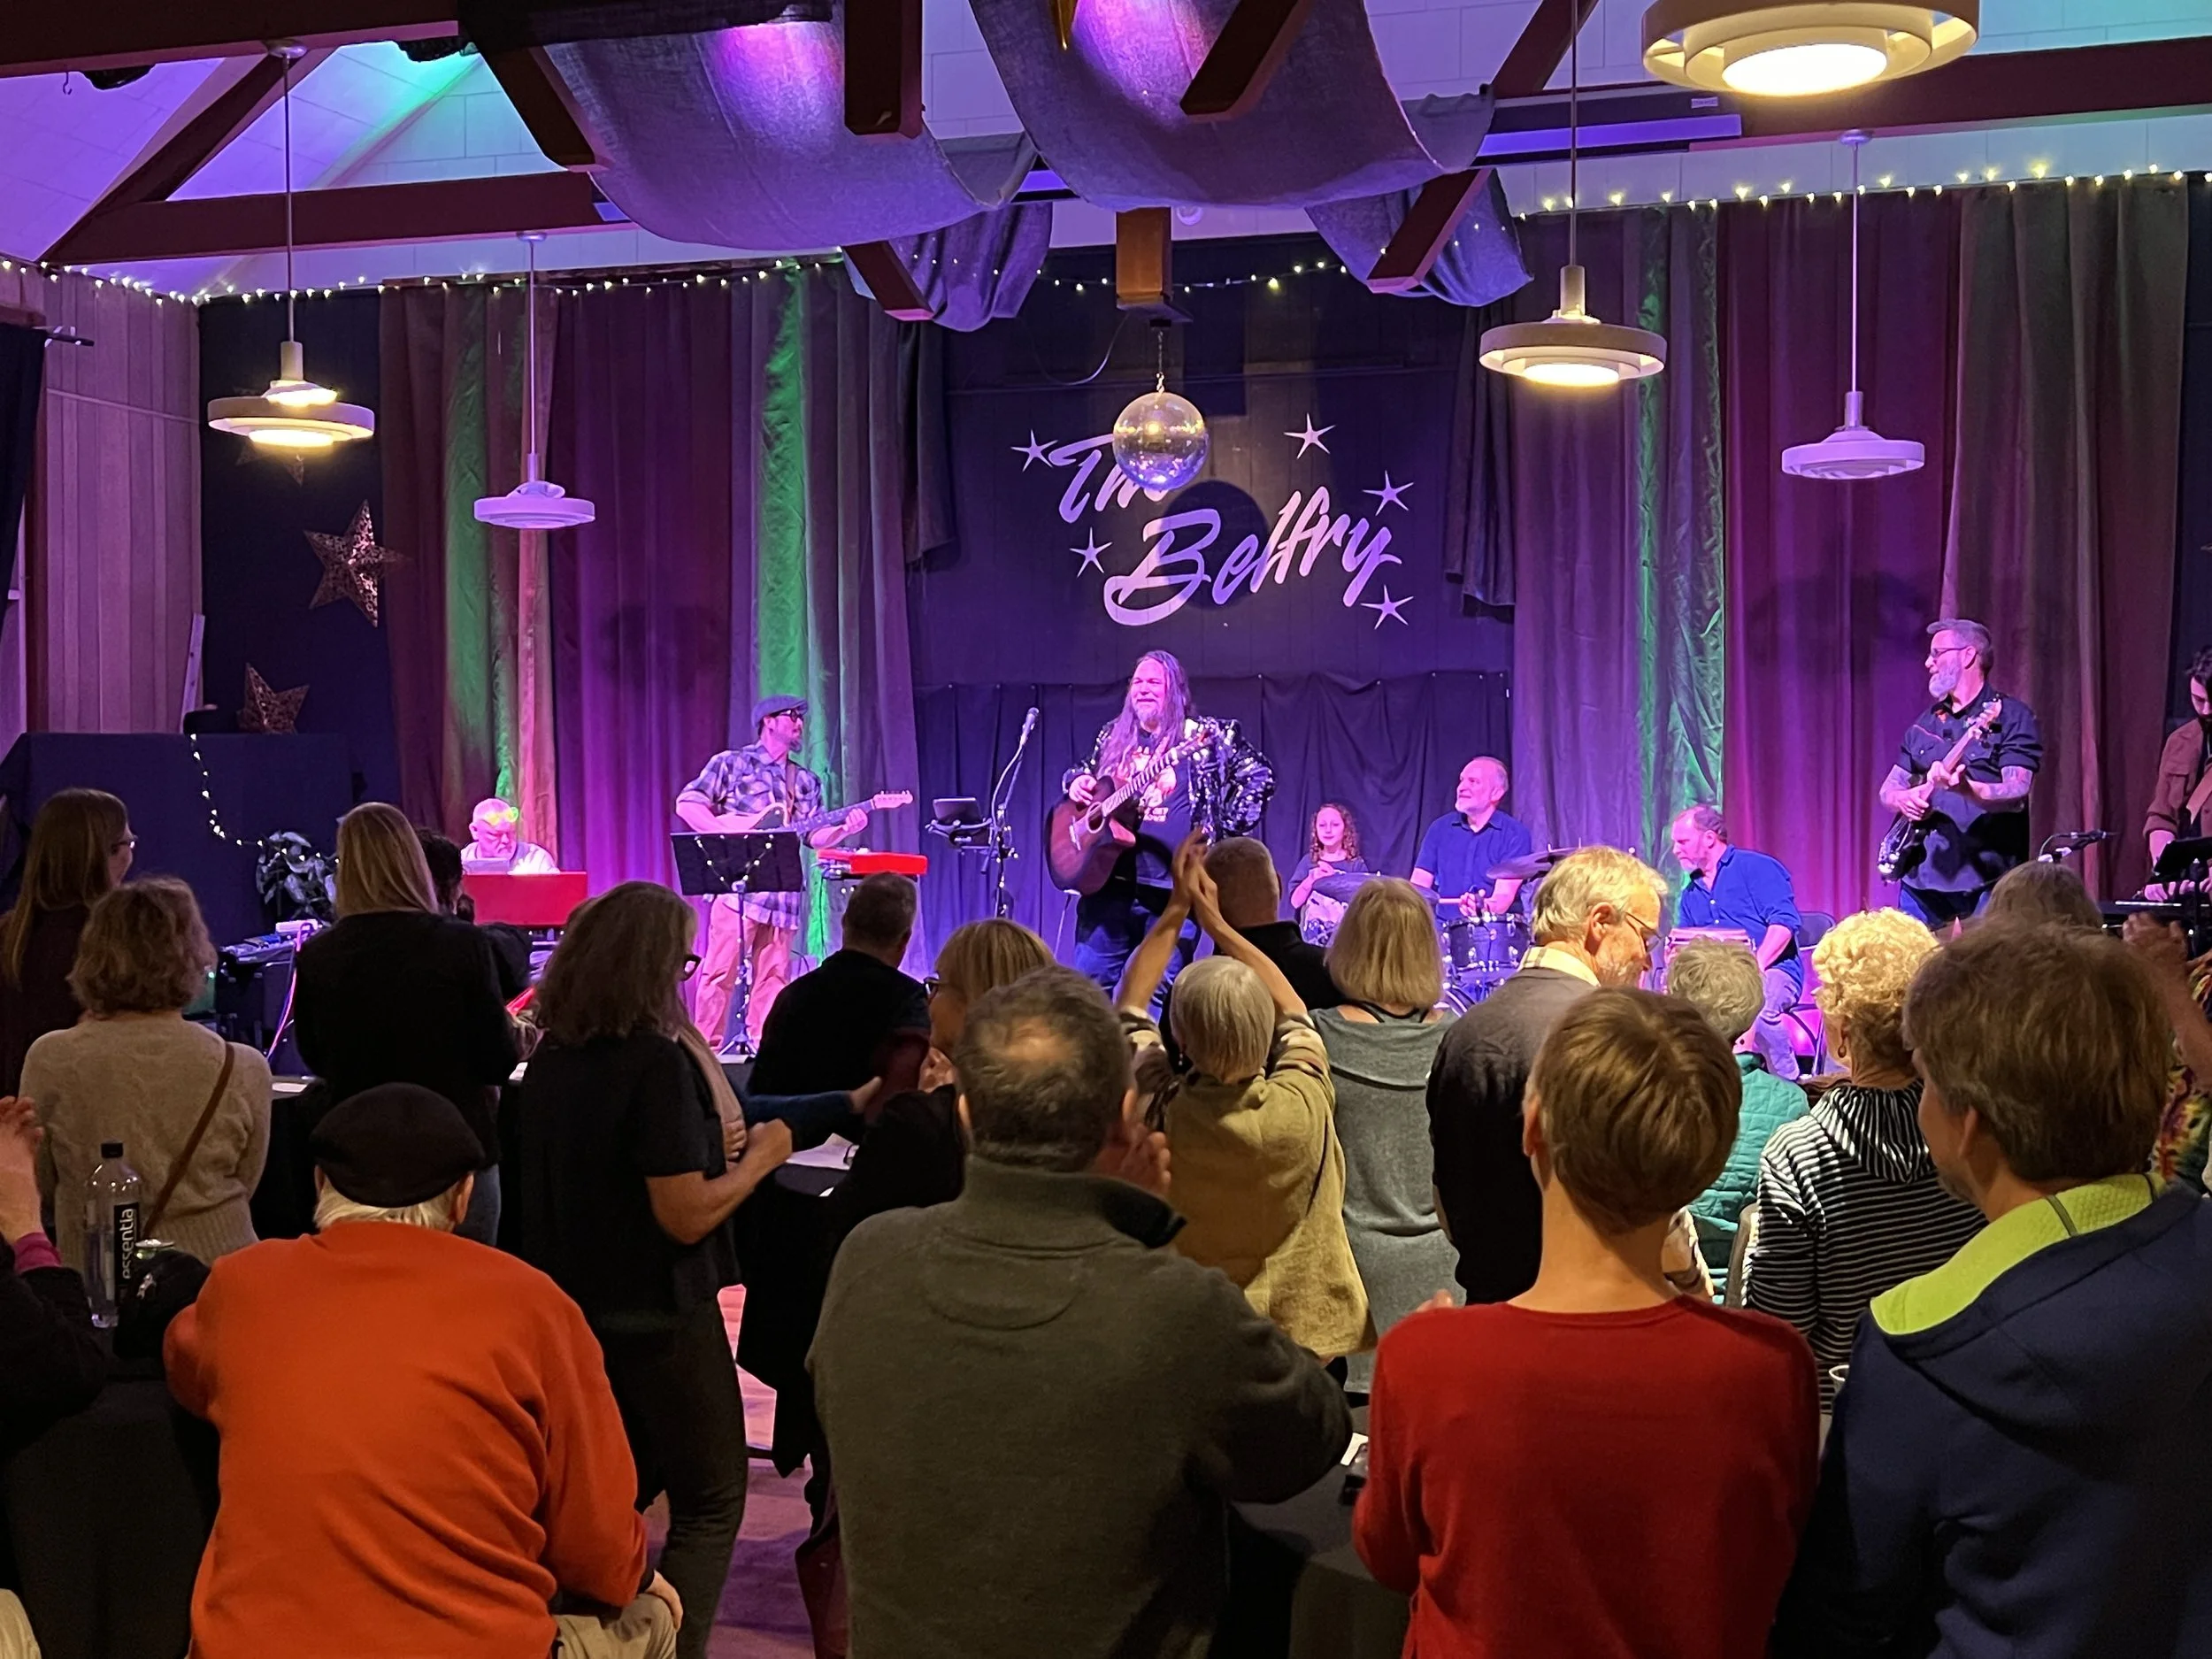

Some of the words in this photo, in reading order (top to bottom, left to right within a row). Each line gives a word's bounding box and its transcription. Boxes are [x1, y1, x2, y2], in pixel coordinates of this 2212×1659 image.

[1048, 434, 1170, 524] Th
[1103, 486, 1402, 626] Belfry
[119, 1209, 134, 1279] essentia
